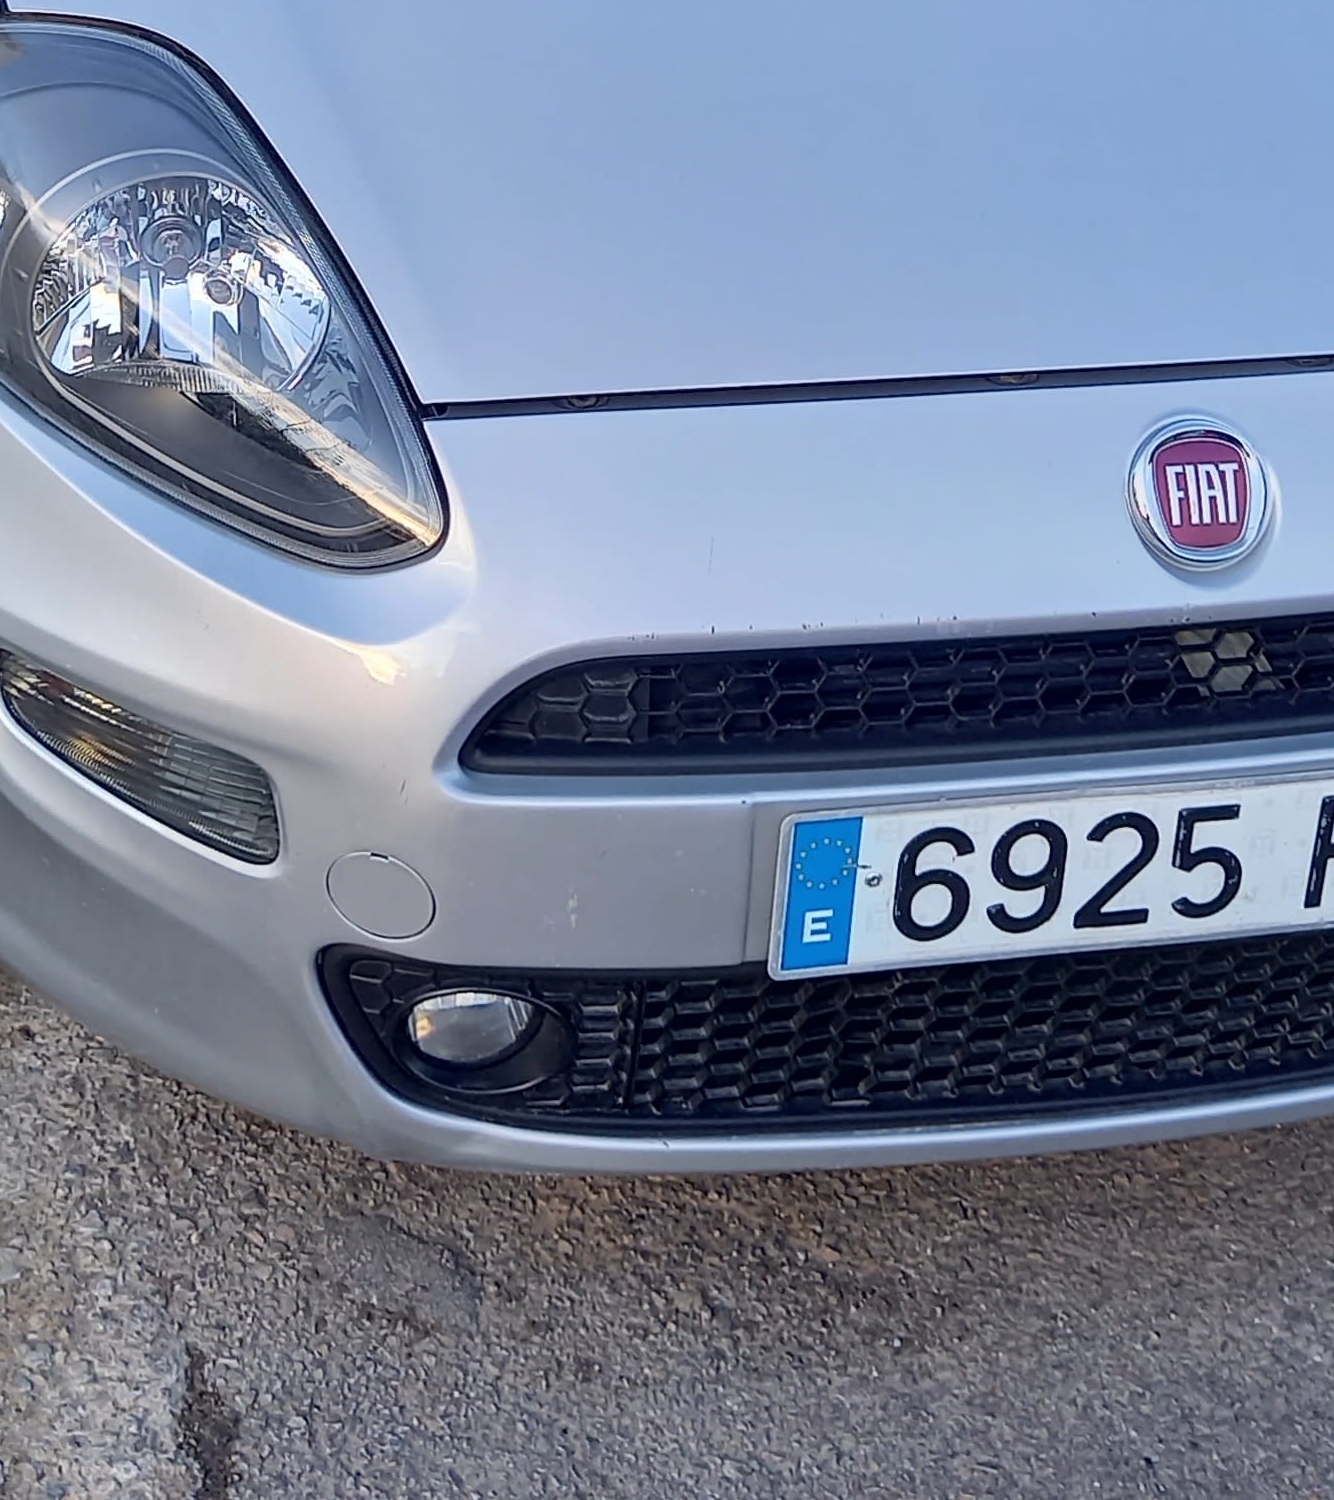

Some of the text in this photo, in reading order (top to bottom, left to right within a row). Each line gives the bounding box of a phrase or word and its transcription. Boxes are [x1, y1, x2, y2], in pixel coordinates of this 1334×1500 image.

[1165, 461, 1240, 527] FIAT
[892, 803, 1243, 942] 6925
[802, 908, 834, 944] E
